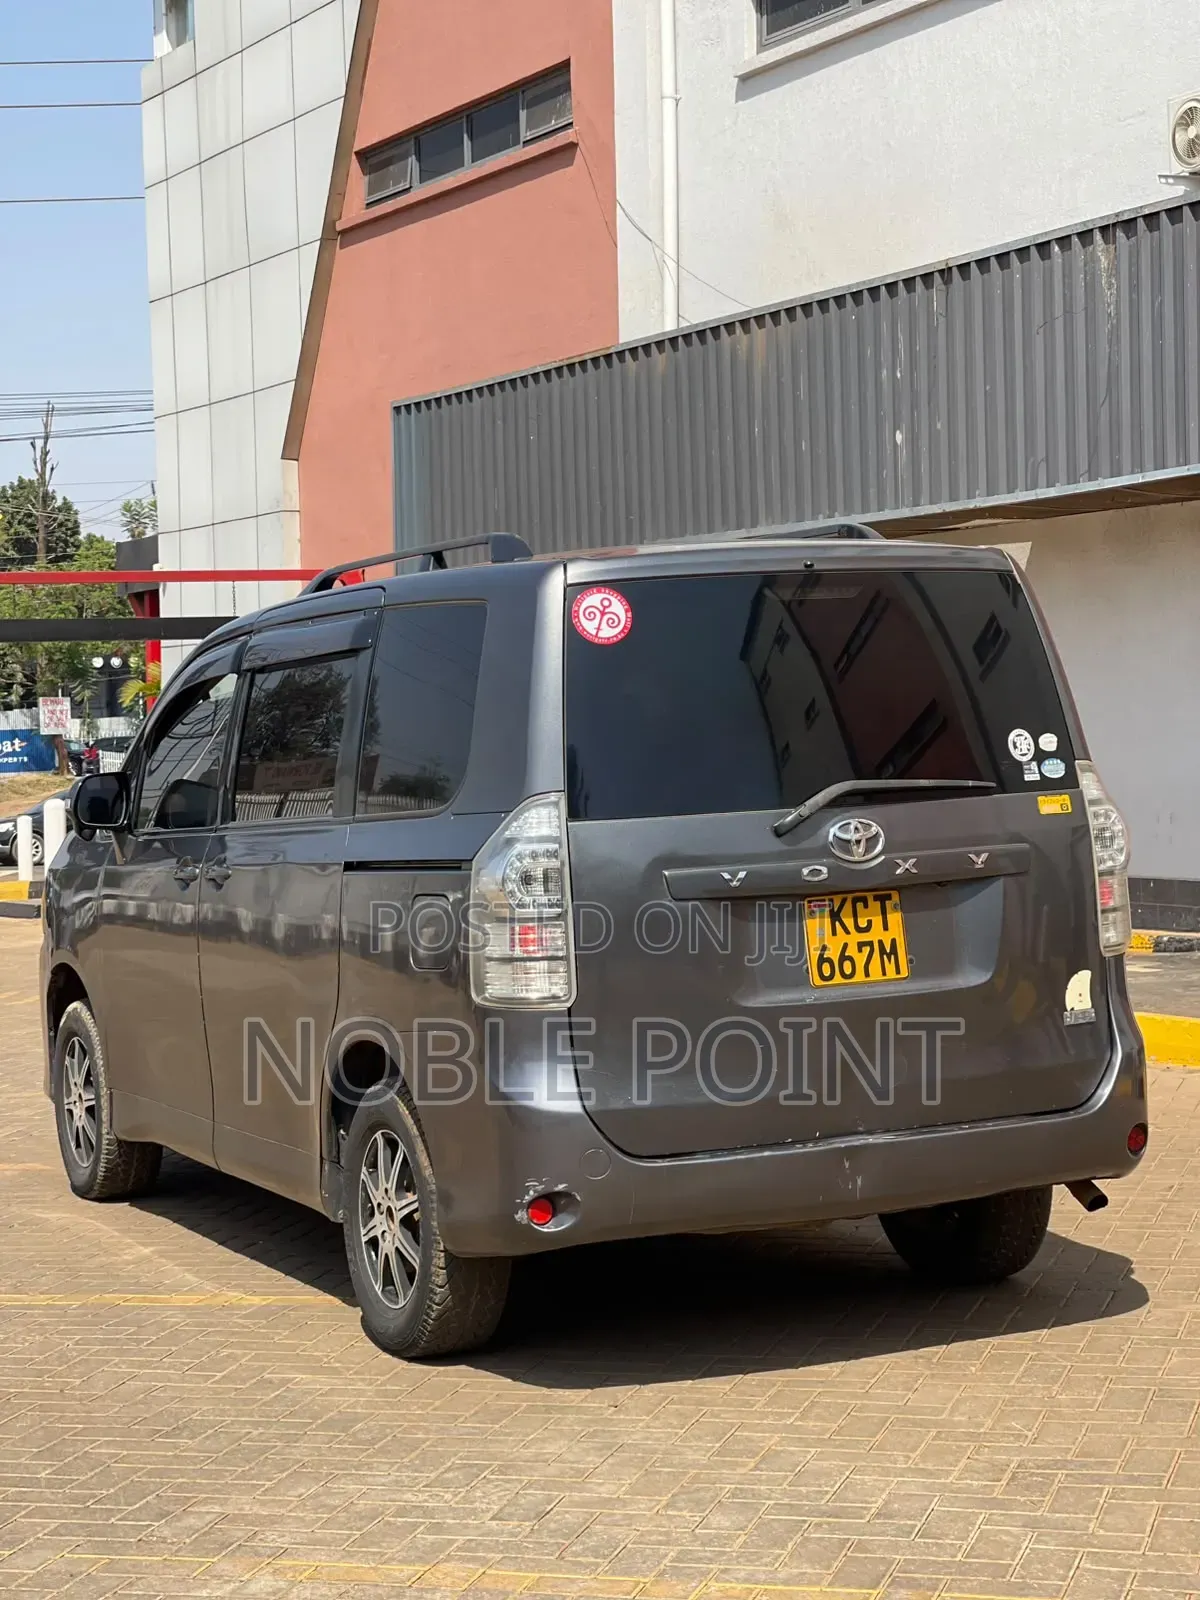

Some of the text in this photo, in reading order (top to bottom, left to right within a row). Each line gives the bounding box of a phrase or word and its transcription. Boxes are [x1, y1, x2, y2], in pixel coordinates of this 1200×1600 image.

[0, 737, 22, 752] at
[720, 852, 989, 888] VOXY
[827, 892, 893, 937] KCT
[816, 937, 902, 982] 667M
